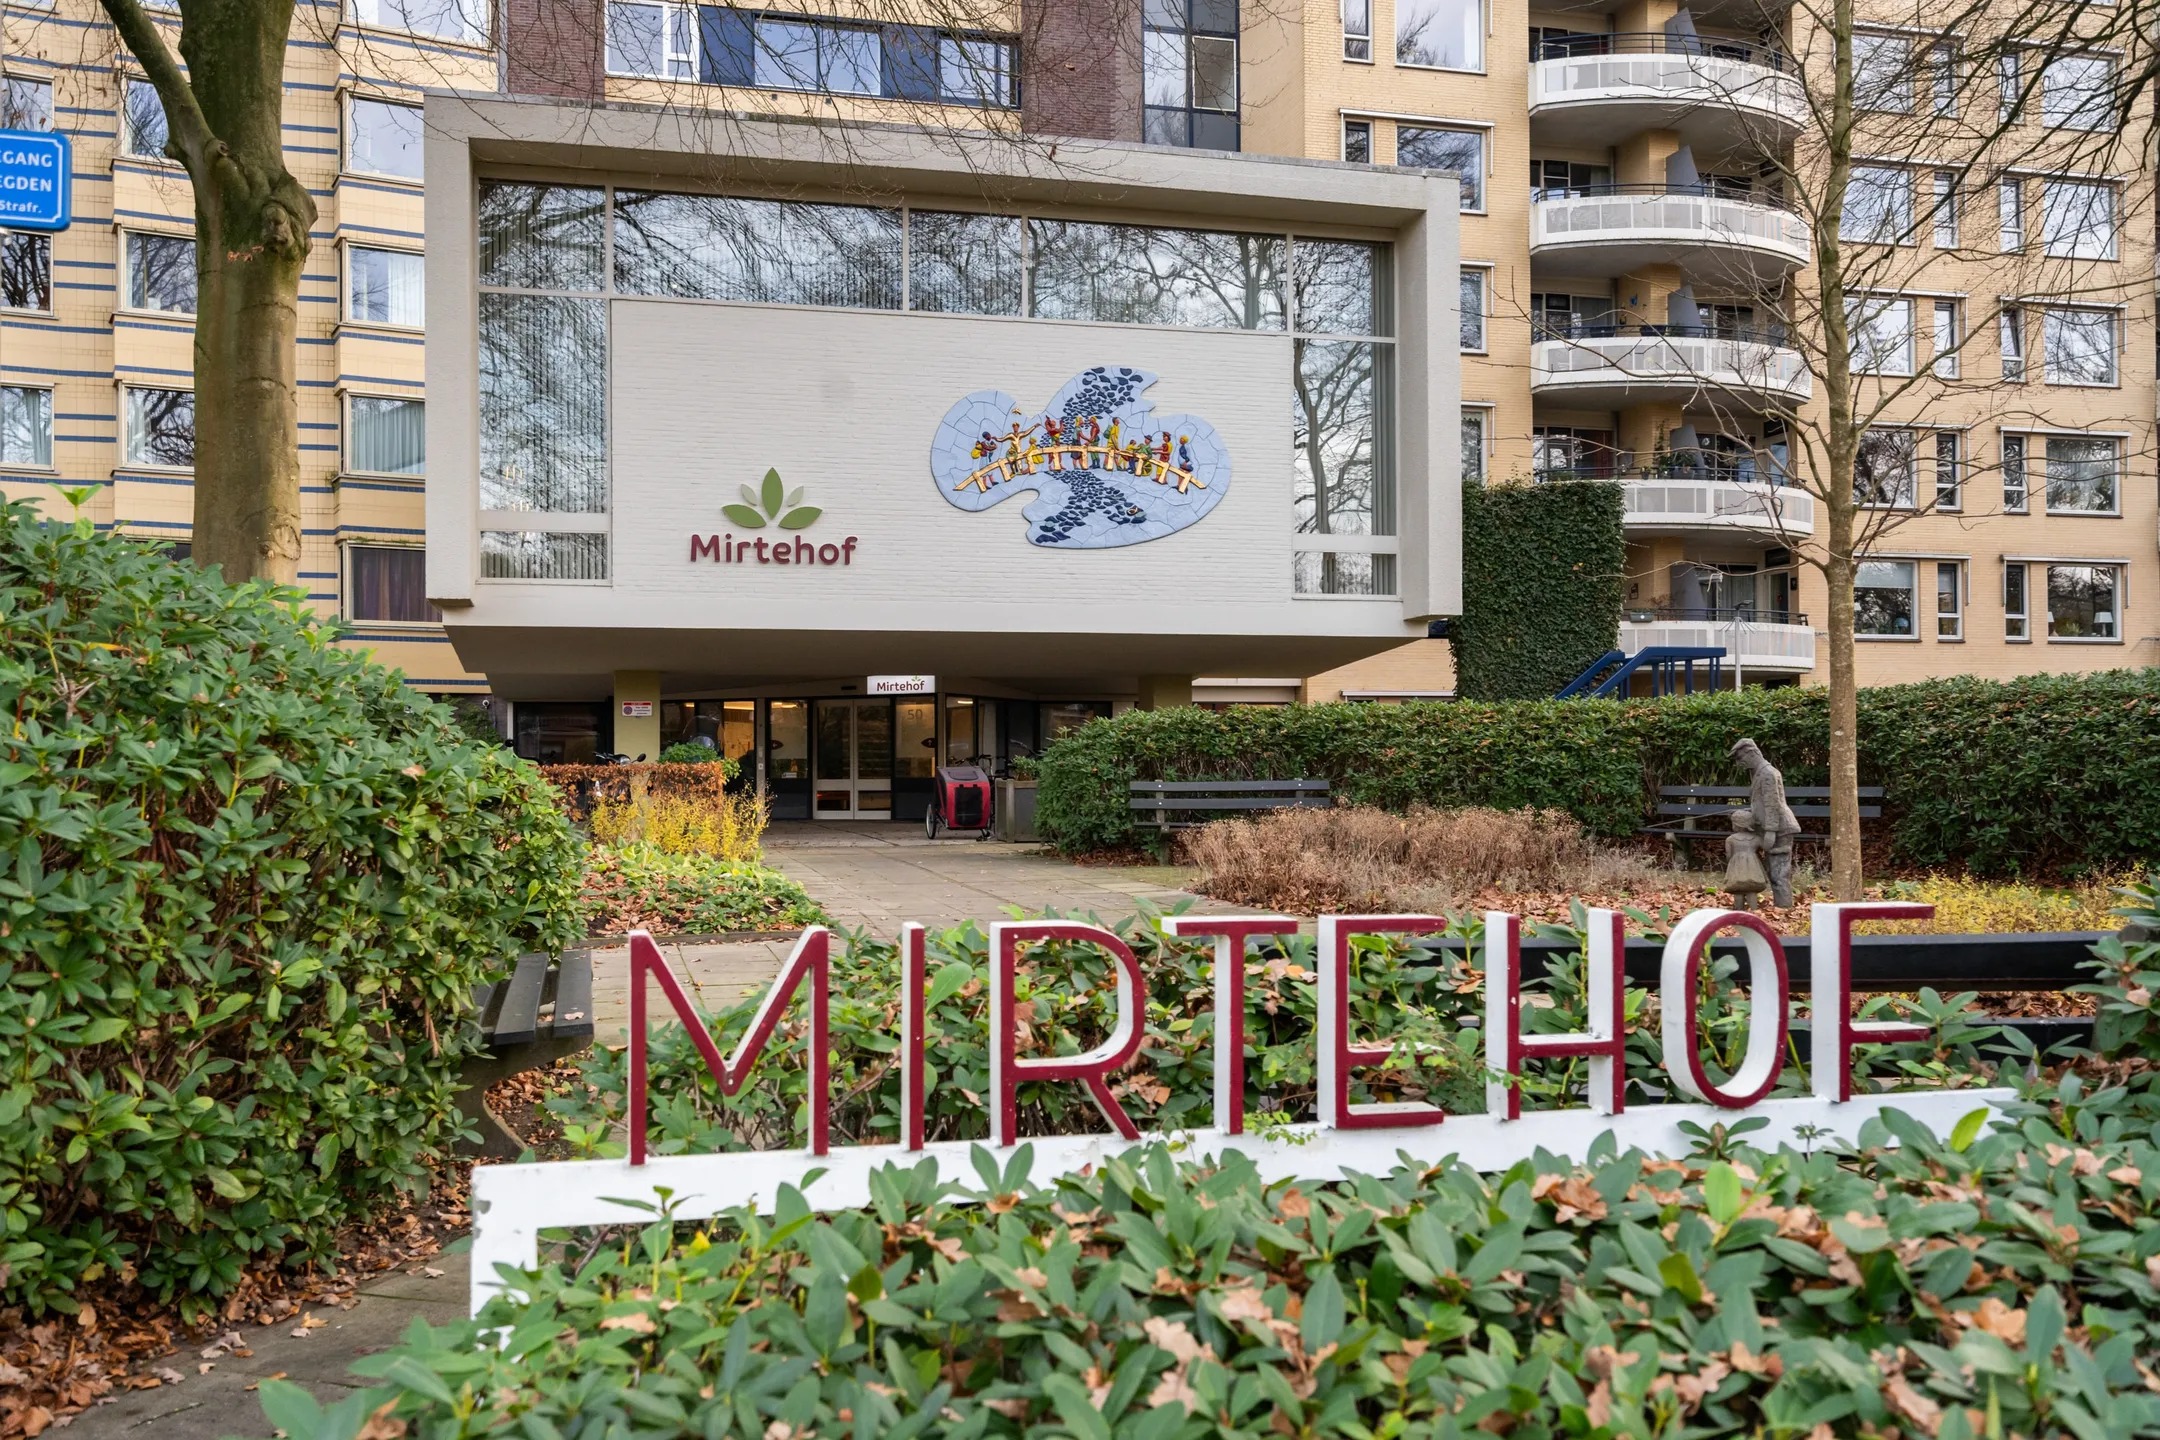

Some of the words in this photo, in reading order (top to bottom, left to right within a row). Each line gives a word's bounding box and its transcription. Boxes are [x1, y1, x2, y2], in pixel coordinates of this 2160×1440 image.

[0, 150, 52, 168] GANG
[690, 533, 858, 565] Mirtehof
[876, 680, 925, 692] Mirtehof
[907, 708, 923, 720] 50
[628, 900, 1936, 1167] MIRTEHOF
